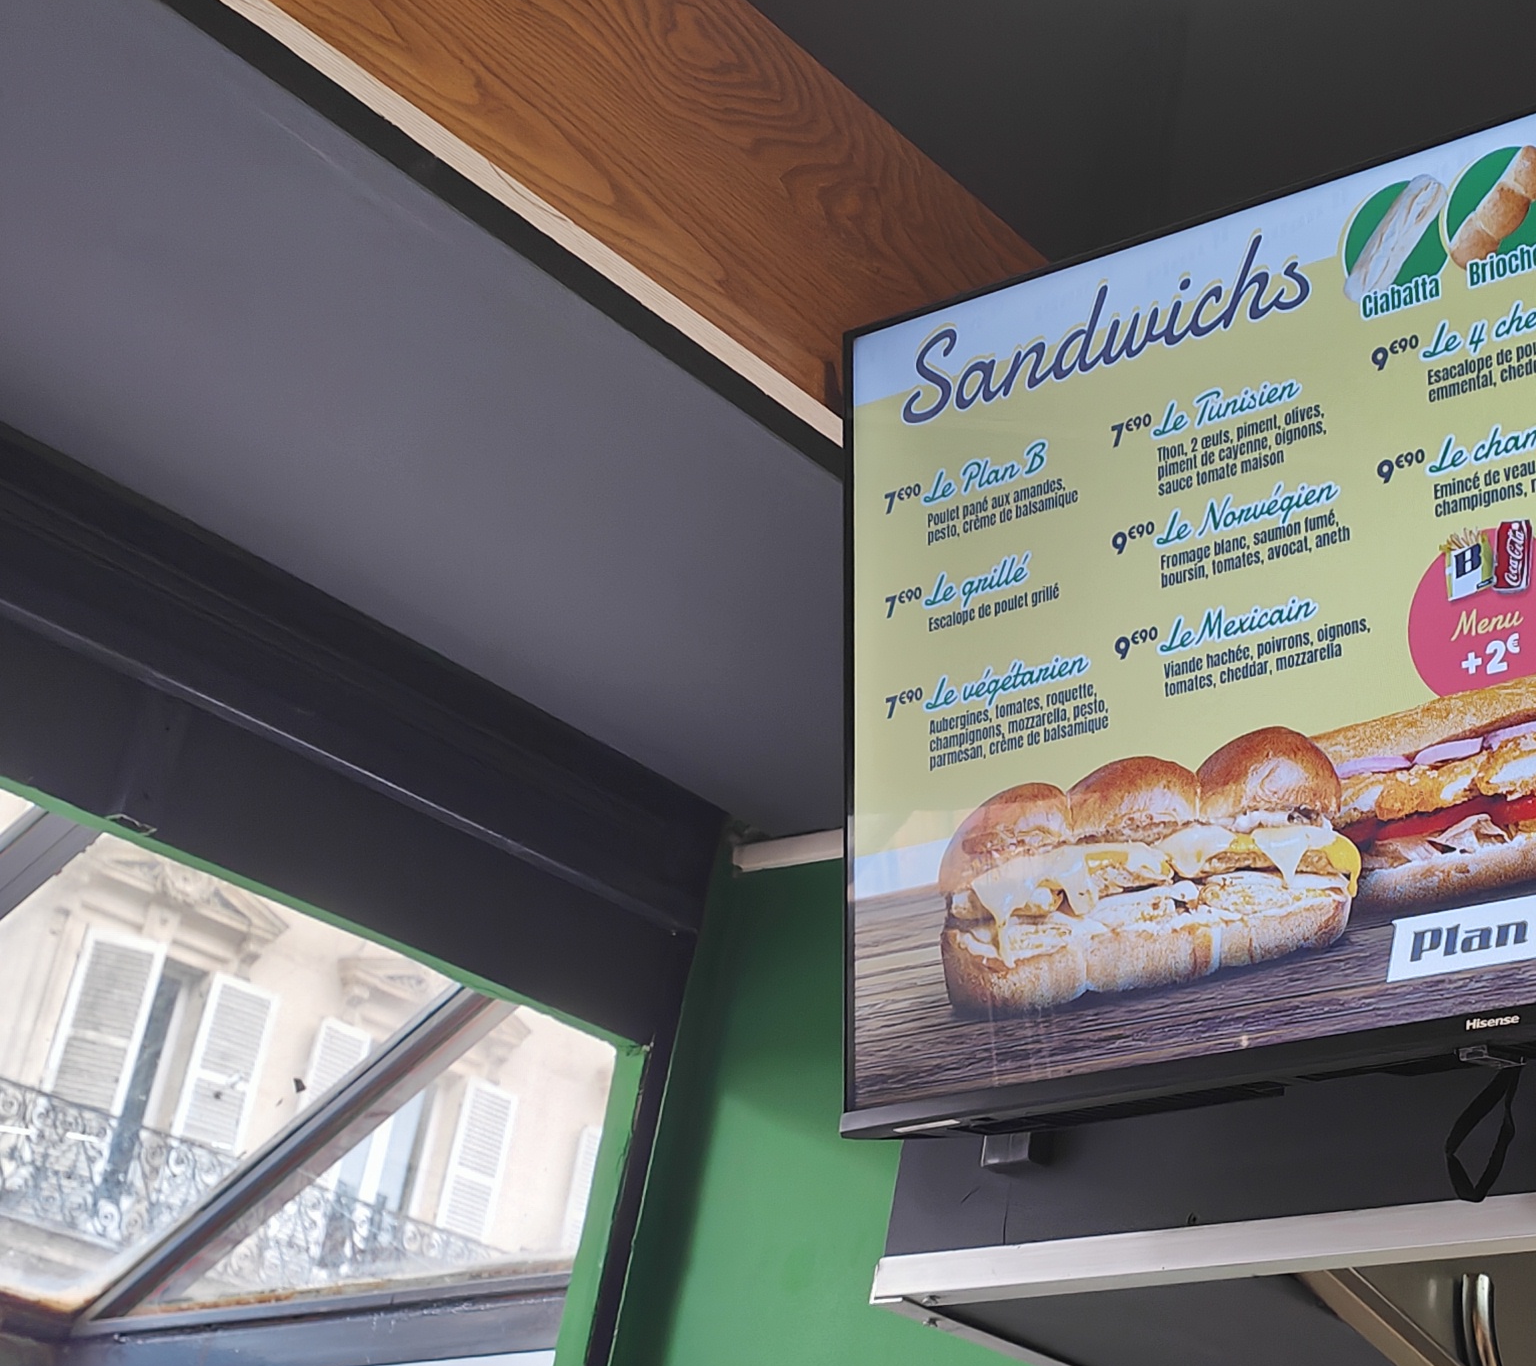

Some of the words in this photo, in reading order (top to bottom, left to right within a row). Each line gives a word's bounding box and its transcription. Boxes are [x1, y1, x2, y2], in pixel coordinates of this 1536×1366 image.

[1361, 275, 1440, 319] Ciabatta
[902, 235, 1310, 423] Sandwichs
[1371, 335, 1419, 371] 9€90
[1423, 322, 1461, 358] Le
[1469, 323, 1486, 352] 4
[1427, 356, 1494, 386] Esacalope
[1496, 349, 1512, 367] de
[1428, 372, 1497, 403] emmental,
[1111, 413, 1152, 448] 7€90
[1153, 403, 1188, 436] Le
[1196, 383, 1299, 426] Tunisien
[1157, 442, 1187, 463] Thon,
[1191, 439, 1198, 453] 2
[1236, 415, 1281, 442] piment,
[1284, 404, 1325, 427] olives,
[1157, 453, 1197, 481] piment
[1201, 451, 1214, 466] de
[1219, 437, 1271, 465] cayenne,
[1274, 420, 1326, 447] oignons,
[1158, 475, 1193, 496] sauce
[1196, 461, 1237, 485] tomate
[1240, 451, 1284, 475] maison
[1377, 449, 1425, 484] 9€90
[1429, 437, 1467, 473] Le
[884, 483, 921, 515] 7€90
[924, 469, 954, 503] Le
[963, 460, 1020, 492] Plan
[1025, 441, 1046, 475] B
[928, 505, 959, 528] Poulet
[962, 495, 988, 521] pané
[991, 494, 1010, 513] aux
[1013, 478, 1066, 505] amandes,
[1433, 474, 1481, 500] Emincé
[1483, 471, 1500, 486] de
[1434, 483, 1528, 518] champignons,
[927, 523, 961, 545] pesto,
[963, 512, 996, 534] crème
[999, 507, 1013, 523] de
[1015, 489, 1079, 519] balsamique
[1112, 522, 1155, 555] 9€90
[1156, 511, 1192, 545] Le
[1198, 484, 1338, 536] Norvégien
[1160, 543, 1211, 571] Fromage
[1214, 534, 1250, 557] blanc,
[1253, 521, 1301, 546] saumon
[1304, 510, 1339, 535] fumé,
[1161, 563, 1208, 589] boursin,
[1212, 549, 1264, 576] tomates,
[1267, 539, 1312, 561] avocat,
[1315, 527, 1350, 549] aneth
[885, 587, 922, 618] 7€90
[925, 574, 956, 606] Le
[962, 554, 1029, 607] grillé
[928, 606, 975, 632] Escalope
[978, 603, 991, 619] de
[994, 592, 1029, 618] poulet
[1031, 582, 1060, 608] grillé
[1114, 626, 1158, 660] 9€90
[1160, 618, 1194, 652] Le
[1196, 599, 1316, 645] Mexicain
[1163, 652, 1203, 680] Viande
[1206, 644, 1253, 670] hachée,
[1256, 631, 1314, 657] poivrons,
[1316, 618, 1371, 643] oignons,
[1451, 609, 1524, 641] Menu
[1164, 674, 1216, 697] tomates,
[1220, 659, 1273, 685] cheddar,
[1275, 643, 1342, 671] mozzarella
[1462, 633, 1520, 675] +2€
[885, 688, 923, 719] 7€90
[925, 677, 957, 710] Le
[963, 657, 1089, 706] végétarien
[930, 707, 993, 735] Aubergines,
[995, 697, 1043, 719] tomates,
[1046, 683, 1097, 711] roquette,
[930, 725, 1003, 753] champignons,
[1008, 706, 1071, 734] mozzarella,
[1073, 699, 1108, 722] pesto,
[930, 746, 986, 771] parmesan,
[989, 732, 1024, 756] crème
[1027, 728, 1040, 746] de
[1043, 715, 1109, 743] balsamique
[1410, 920, 1528, 962] Plan
[1466, 1015, 1520, 1030] Hisense
